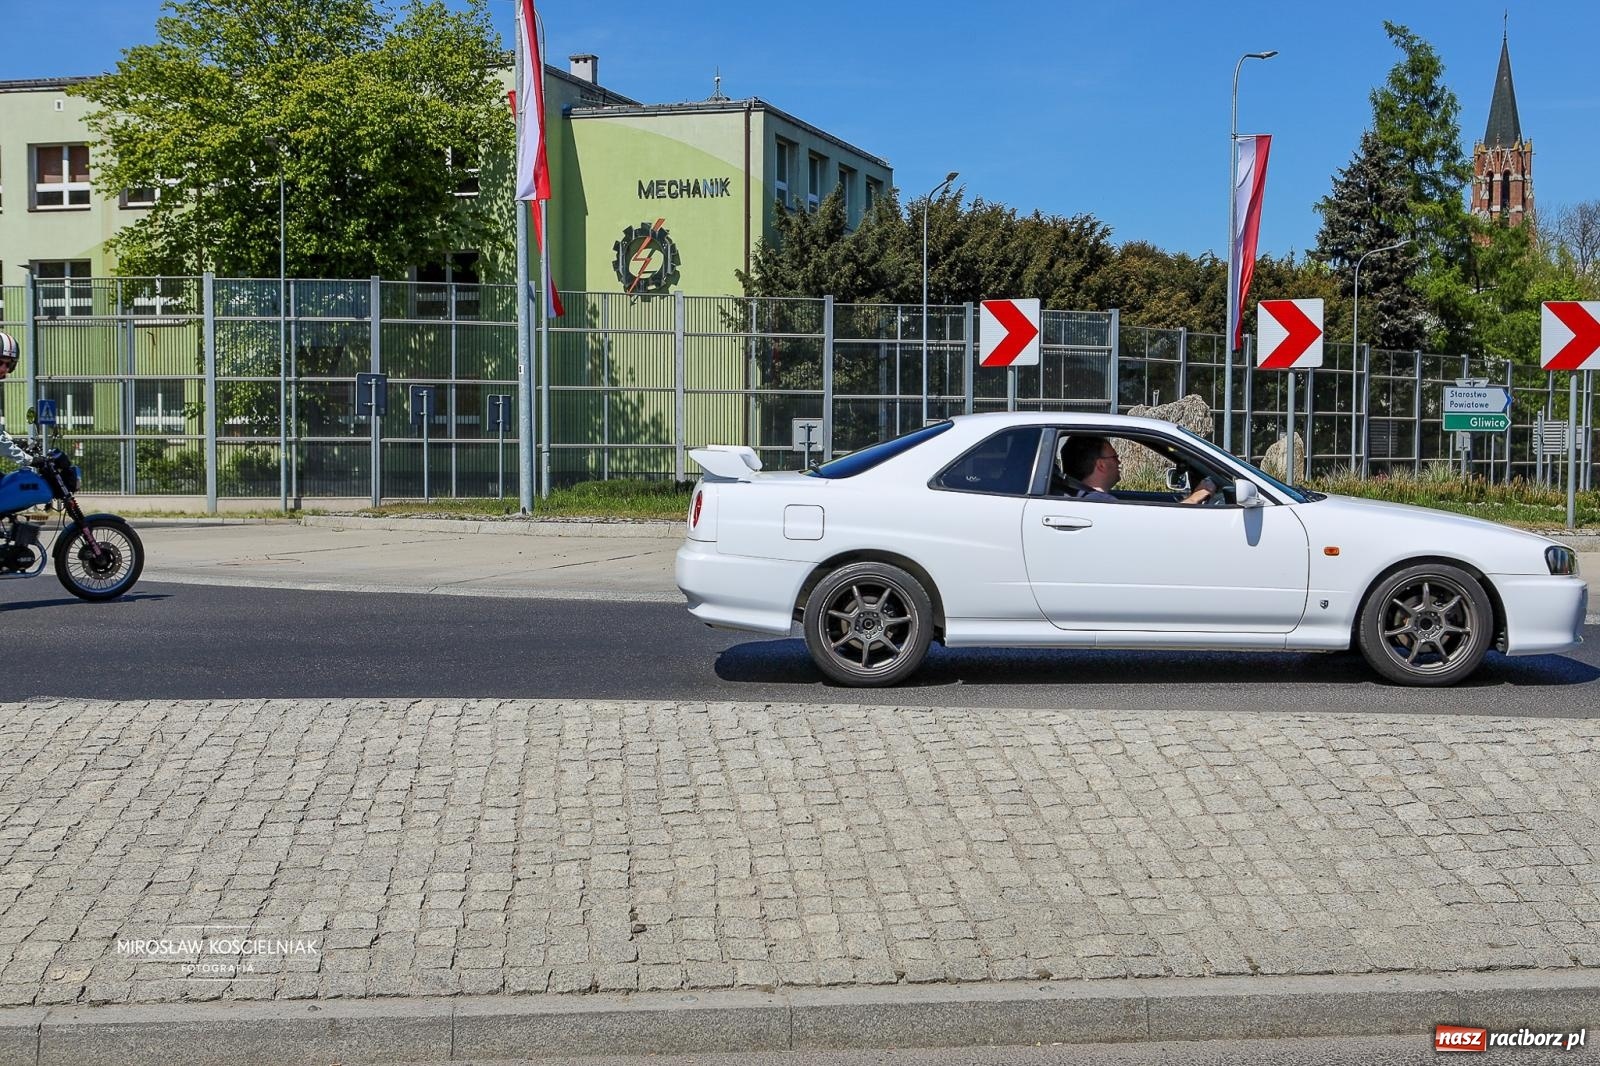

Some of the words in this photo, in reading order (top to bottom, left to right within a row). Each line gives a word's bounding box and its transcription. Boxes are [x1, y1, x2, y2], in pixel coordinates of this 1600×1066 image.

[638, 177, 731, 199] MECHANIK
[1450, 390, 1487, 398] Starostwo
[1449, 400, 1490, 408] Powiatowe
[1470, 417, 1505, 428] Gliwice
